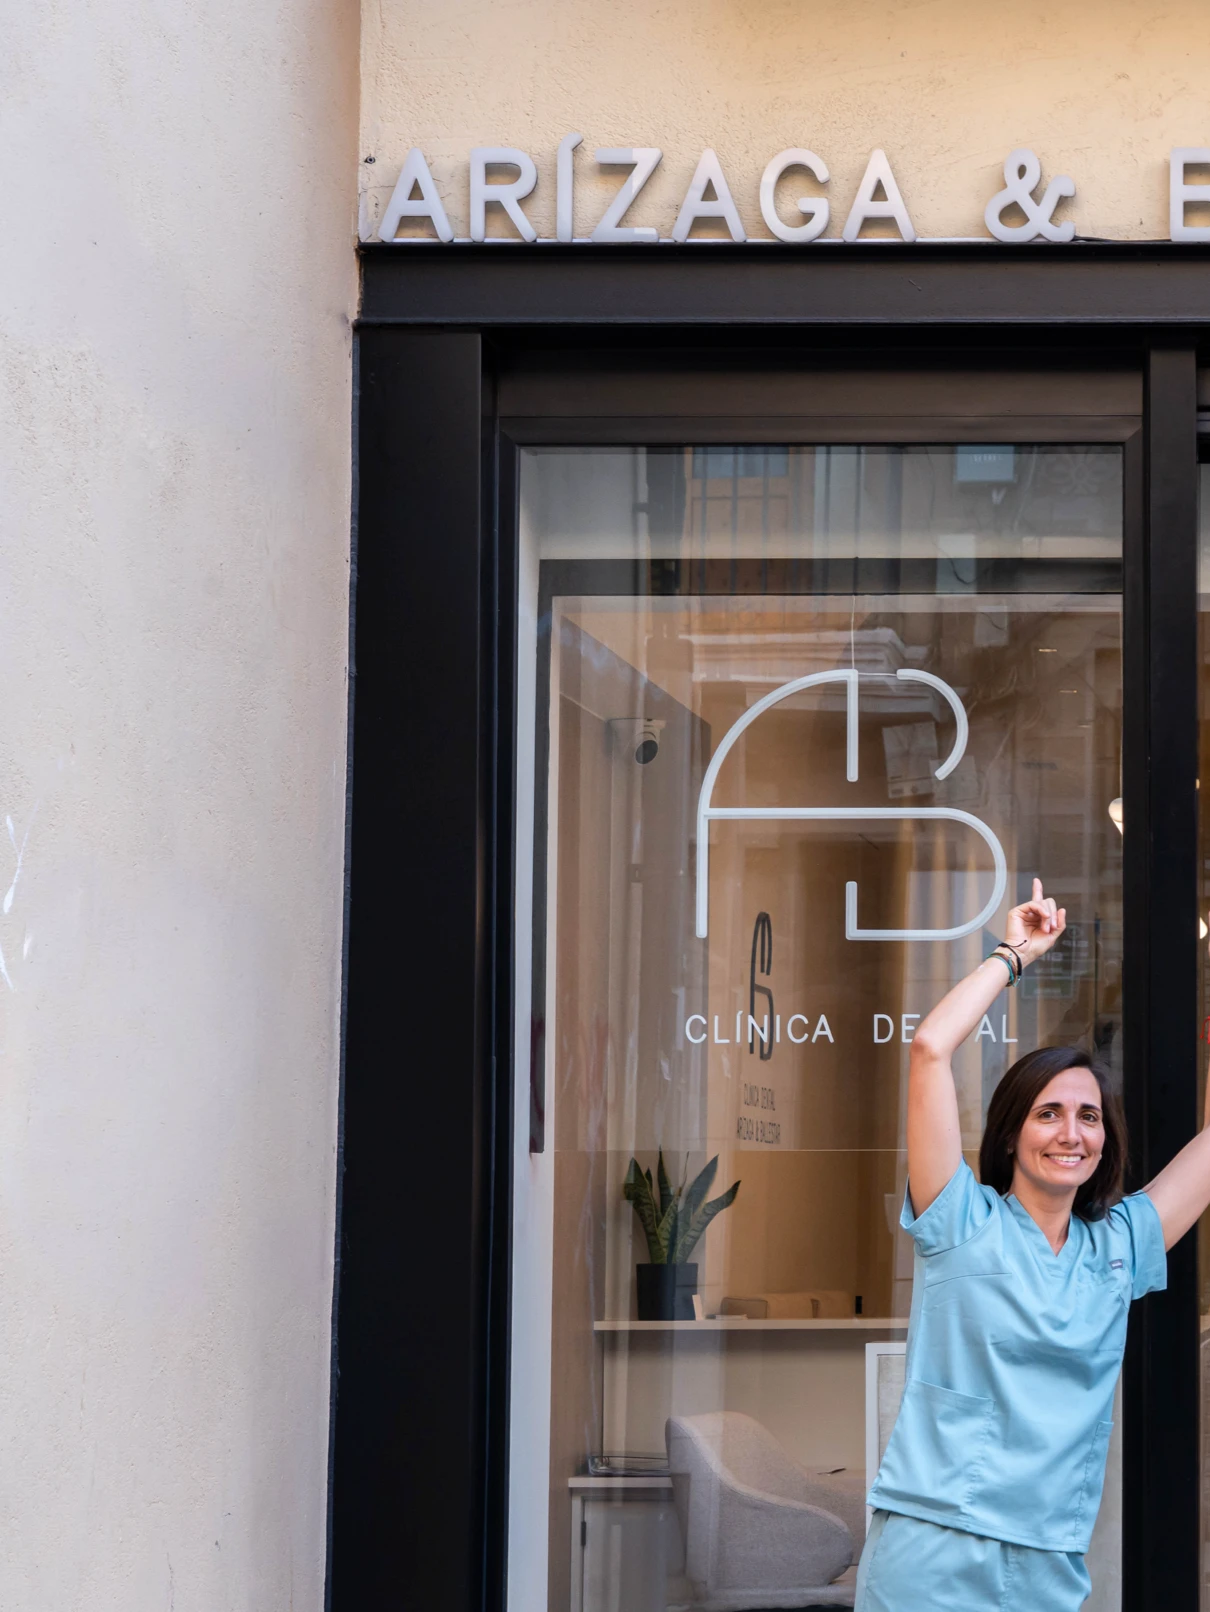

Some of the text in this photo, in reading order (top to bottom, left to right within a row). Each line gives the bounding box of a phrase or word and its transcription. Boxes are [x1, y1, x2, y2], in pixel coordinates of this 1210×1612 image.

[378, 133, 917, 244] ARÍZAGA
[983, 147, 1077, 243] &
[685, 1010, 1018, 1044] CLÍNICA DEAL
